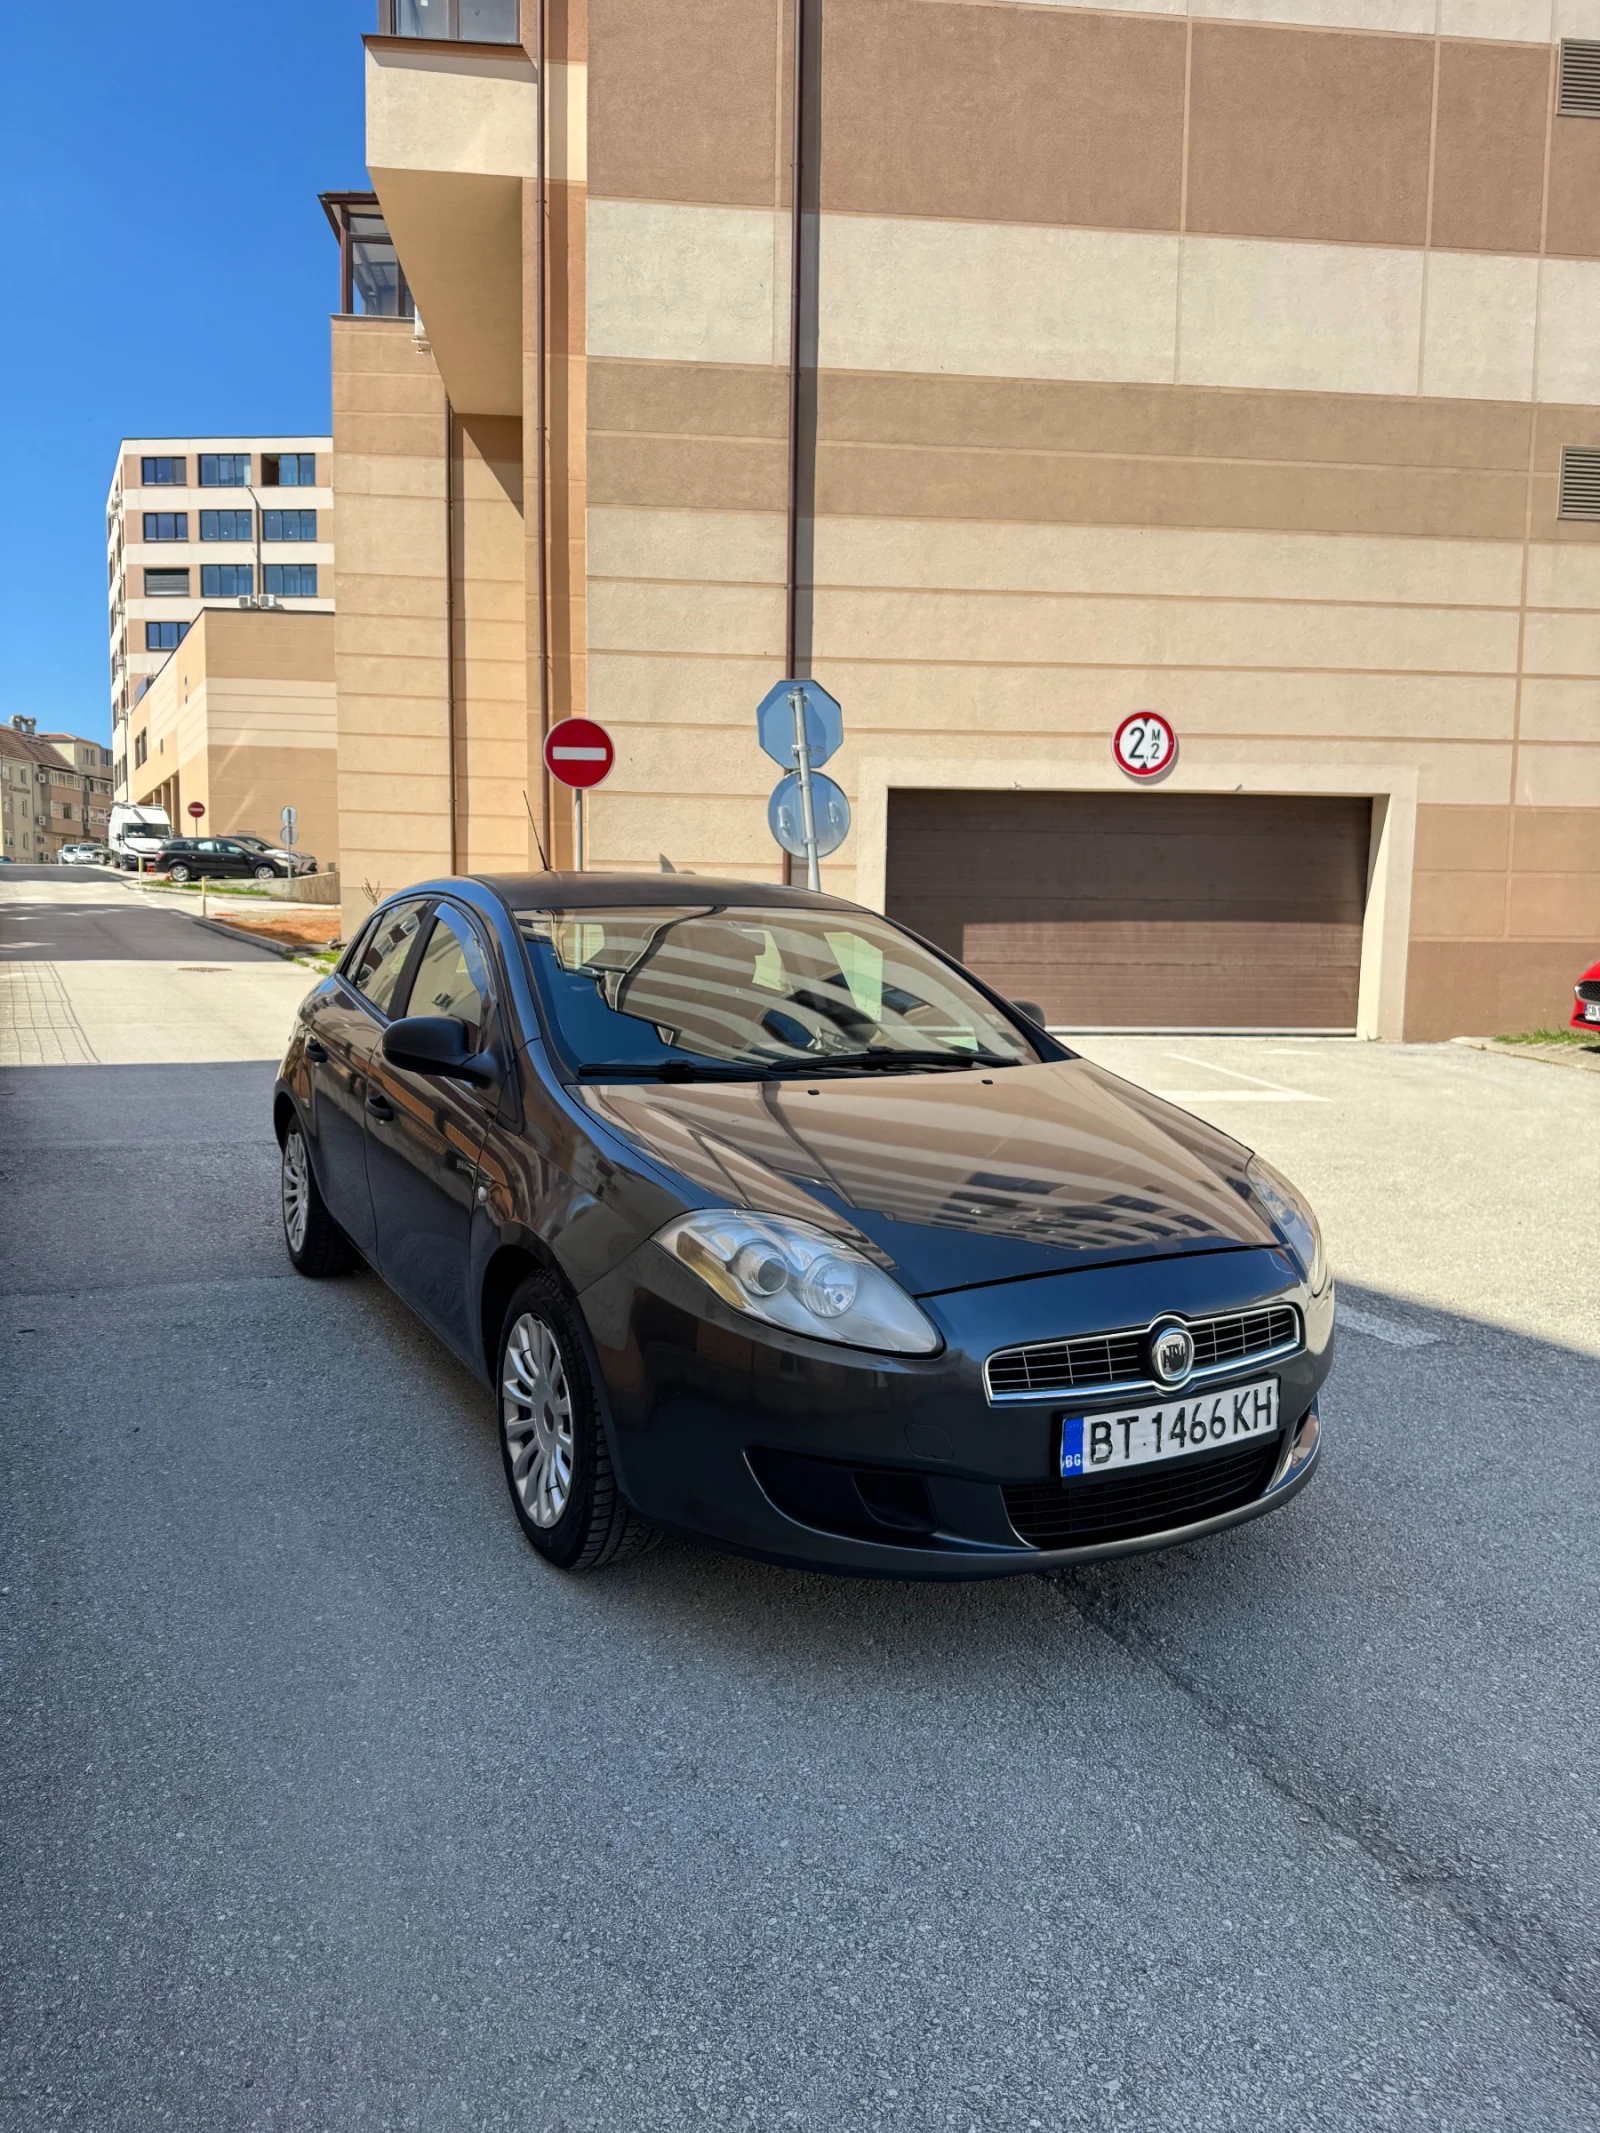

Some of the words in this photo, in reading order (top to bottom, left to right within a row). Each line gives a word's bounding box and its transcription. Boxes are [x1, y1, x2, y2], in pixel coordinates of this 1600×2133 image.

[1089, 1415, 1141, 1466] BT
[1151, 1396, 1227, 1454] 1466
[1233, 1386, 1272, 1435] KH
[1065, 1454, 1081, 1468] BG
